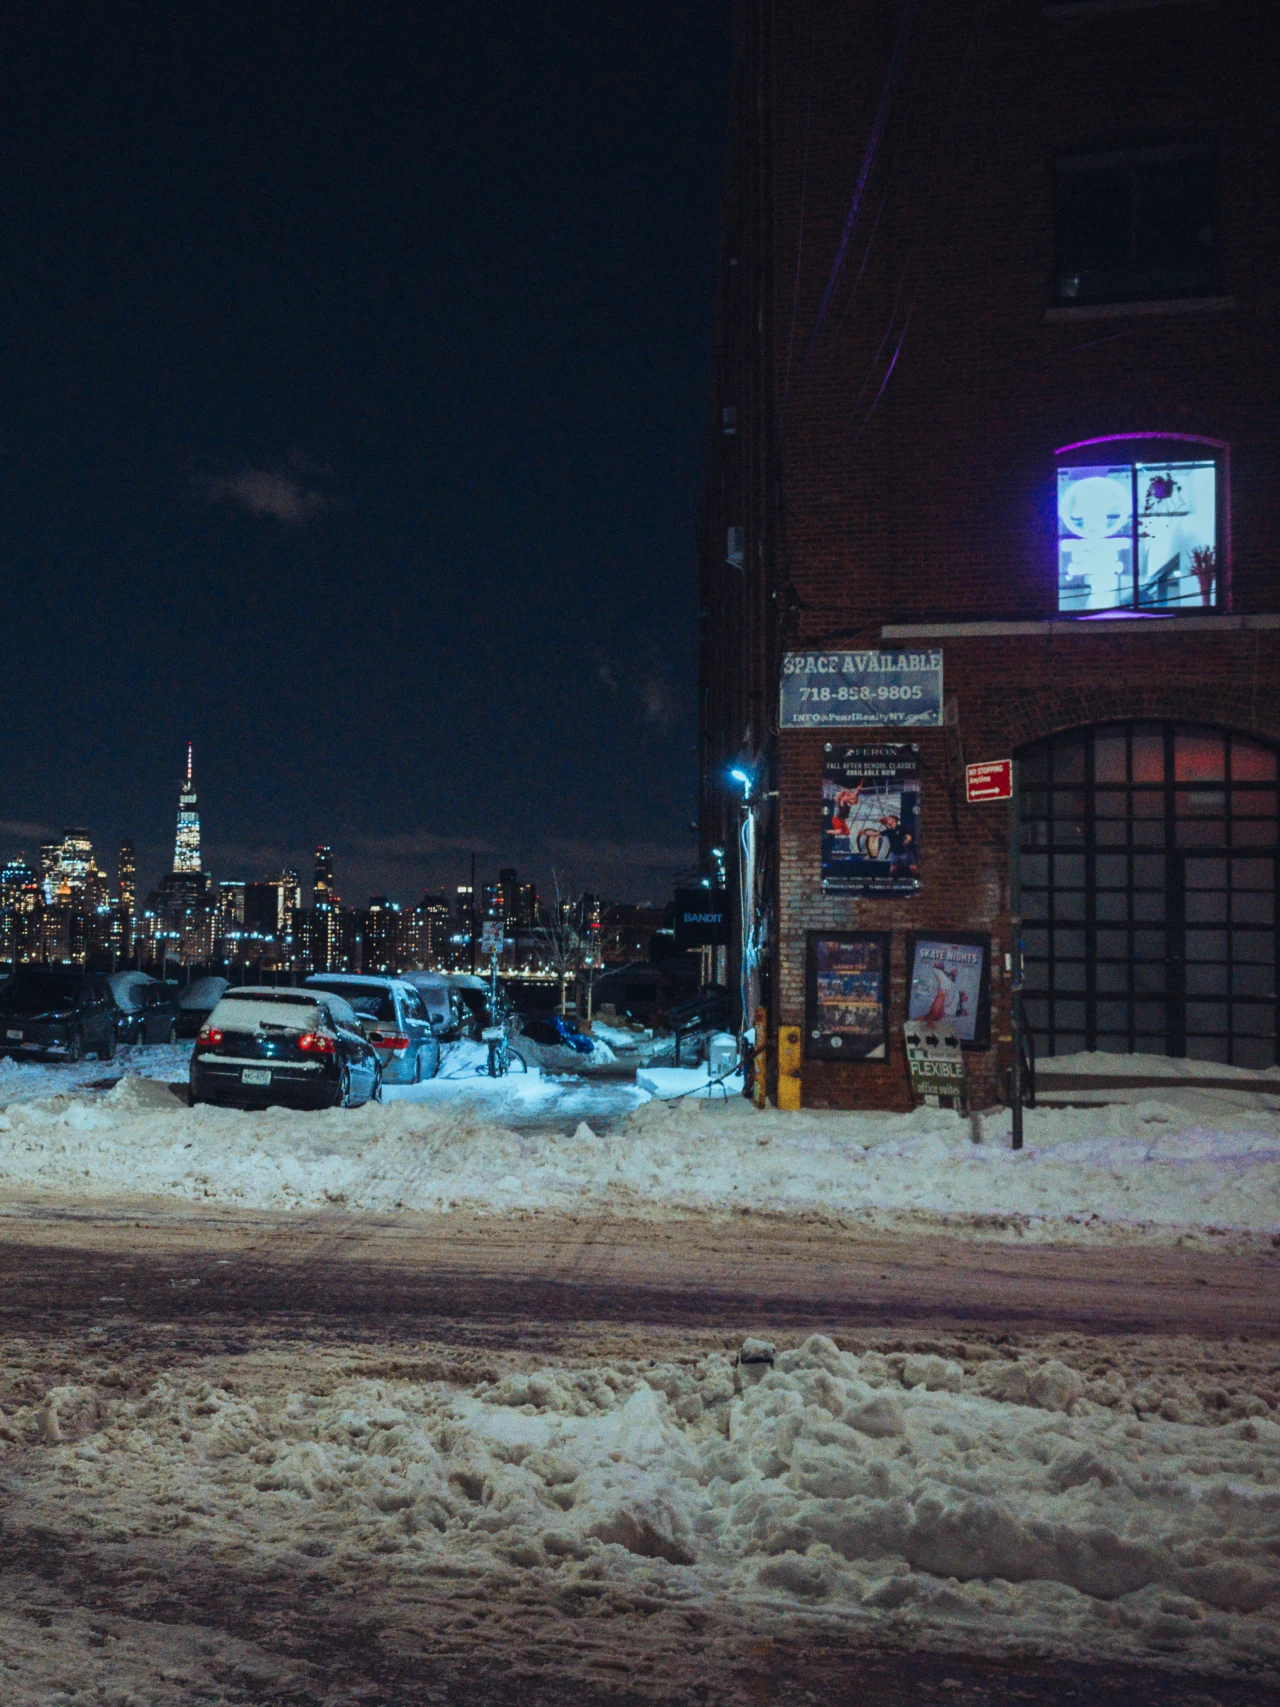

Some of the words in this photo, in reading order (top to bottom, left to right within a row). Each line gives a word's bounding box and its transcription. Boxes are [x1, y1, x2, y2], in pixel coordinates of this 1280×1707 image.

[783, 655, 839, 674] SPACE
[841, 653, 941, 672] AVAILABLE
[855, 748, 898, 756] FEROX
[826, 762, 841, 770] FALL
[842, 762, 863, 770] AFTER
[863, 762, 887, 770] SCHOOL
[888, 762, 916, 770] CLASSES
[968, 768, 977, 776] NO
[977, 764, 1004, 775] STOPPING
[683, 913, 723, 923] BANDIT
[920, 948, 945, 960] SKATE
[947, 952, 978, 964] NIGHTS
[910, 1060, 964, 1078] FLEXIBLE
[917, 1081, 939, 1095] office
